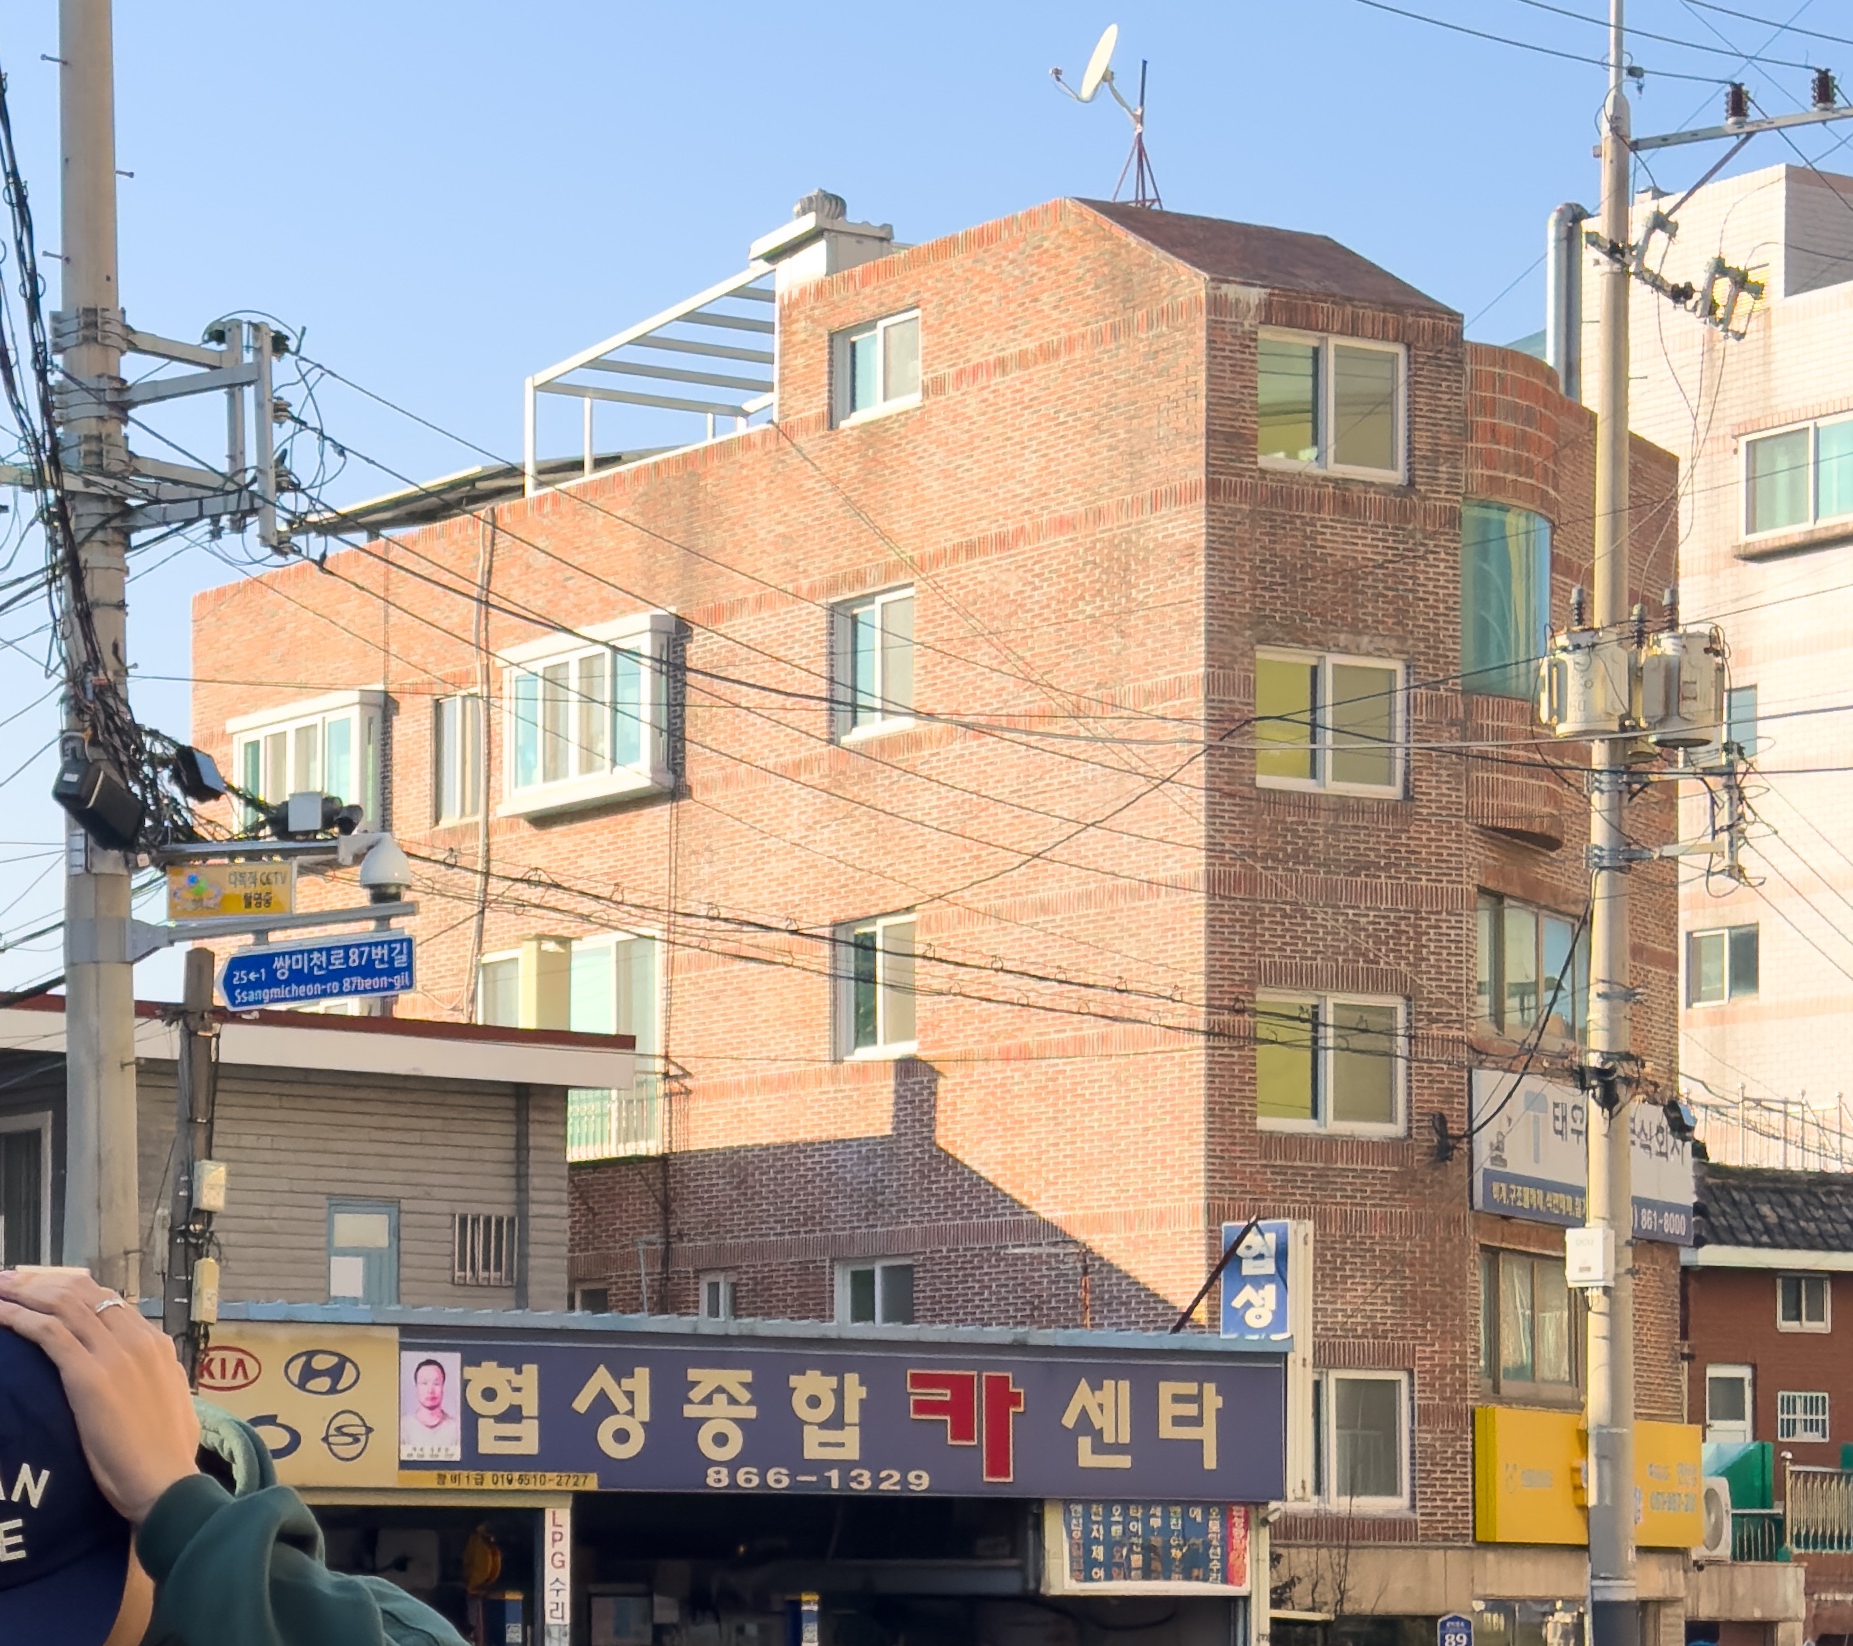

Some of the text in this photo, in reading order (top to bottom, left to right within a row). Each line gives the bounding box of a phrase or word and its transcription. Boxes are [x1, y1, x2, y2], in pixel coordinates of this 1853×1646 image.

[260, 871, 287, 886] CCTV
[272, 942, 408, 981] 쌍미천로87번길
[232, 970, 248, 985] 25
[234, 971, 410, 1004] Ssangmicheon-ro 87beon-gil
[1640, 1208, 1687, 1237] 861-8000
[1231, 1228, 1277, 1329] 협성
[200, 1357, 250, 1381] KIA
[705, 1467, 932, 1492] 866-1329
[551, 1510, 566, 1570] LPG
[550, 1577, 566, 1621] 수리
